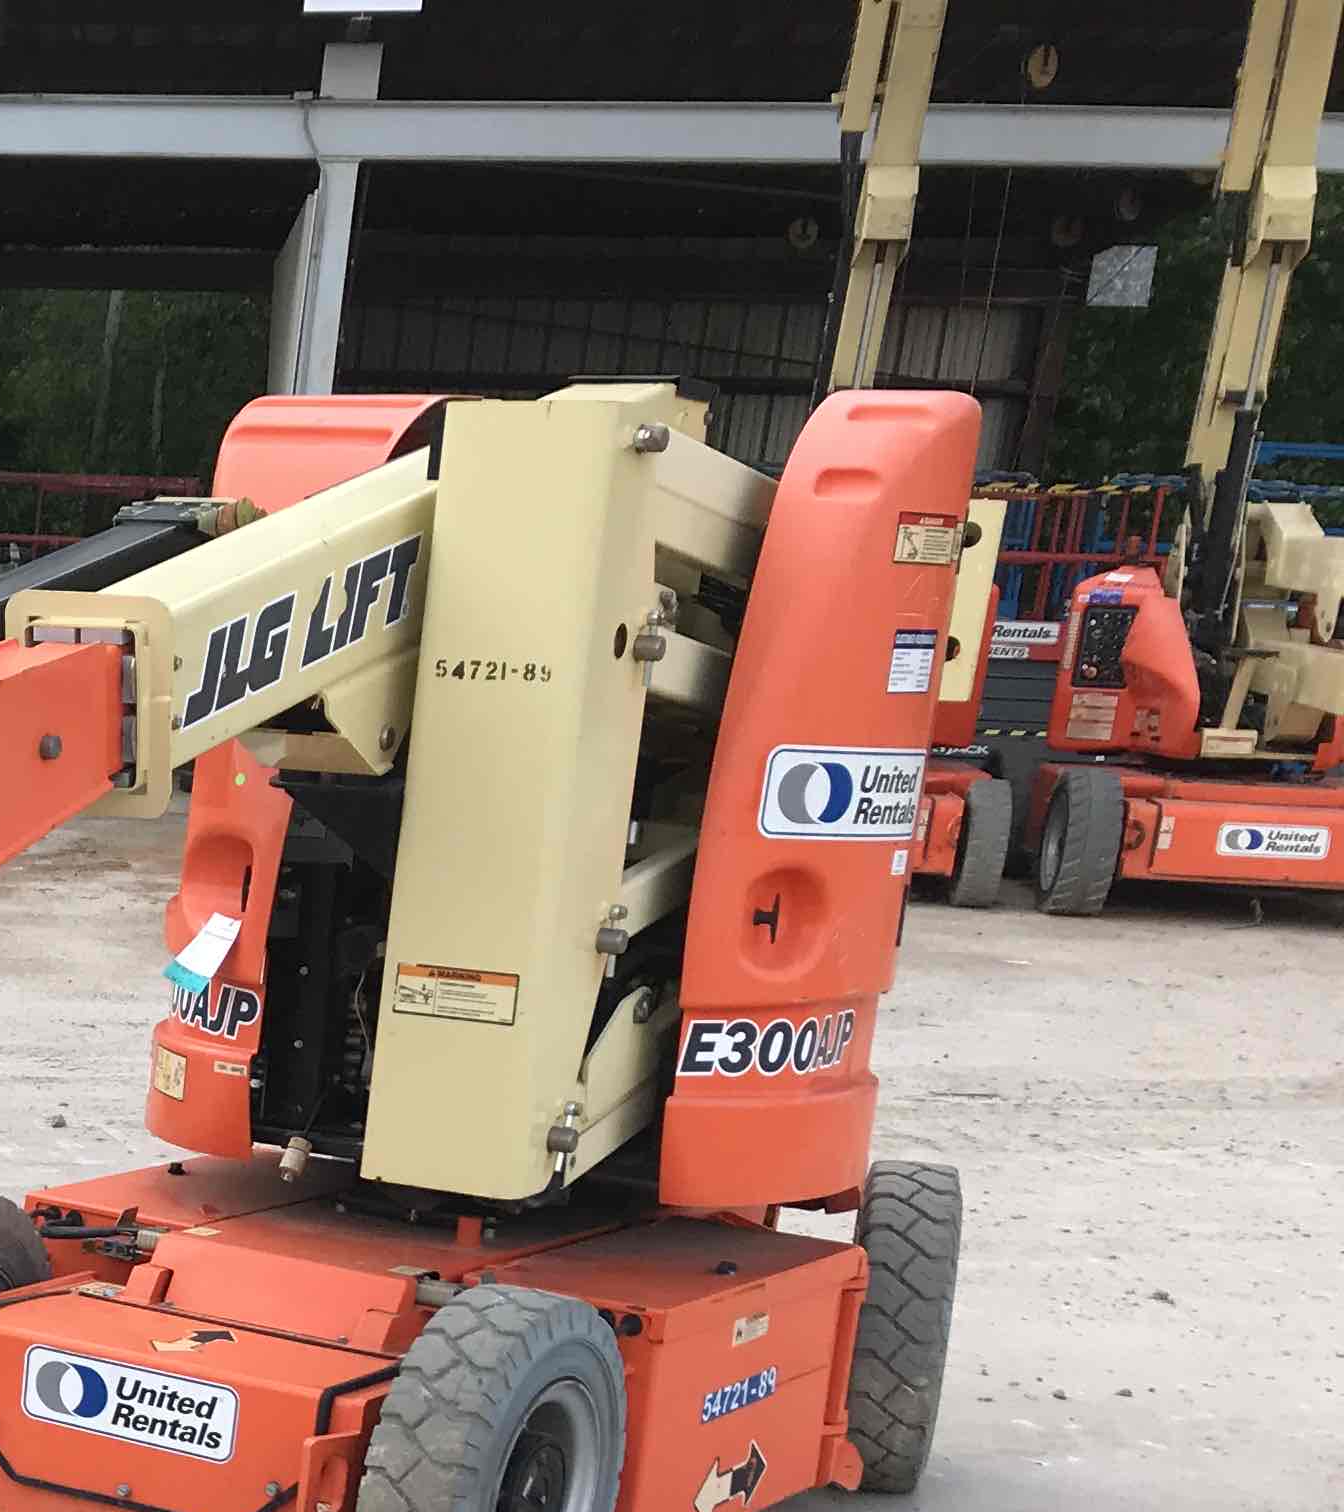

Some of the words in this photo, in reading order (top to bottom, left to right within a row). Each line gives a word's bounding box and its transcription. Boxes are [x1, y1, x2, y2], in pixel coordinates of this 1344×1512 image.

[181, 591, 297, 729] JLG
[299, 531, 423, 672] LIFT
[434, 658, 553, 682] 54721-89
[860, 765, 920, 793] United
[852, 797, 916, 825] Rentals
[1265, 841, 1321, 854] Rentals
[1267, 830, 1320, 842] United
[676, 1008, 856, 1077] E300AJP
[115, 1376, 218, 1420] United
[701, 1365, 777, 1422] 54721-89
[111, 1402, 223, 1449] Rentals
